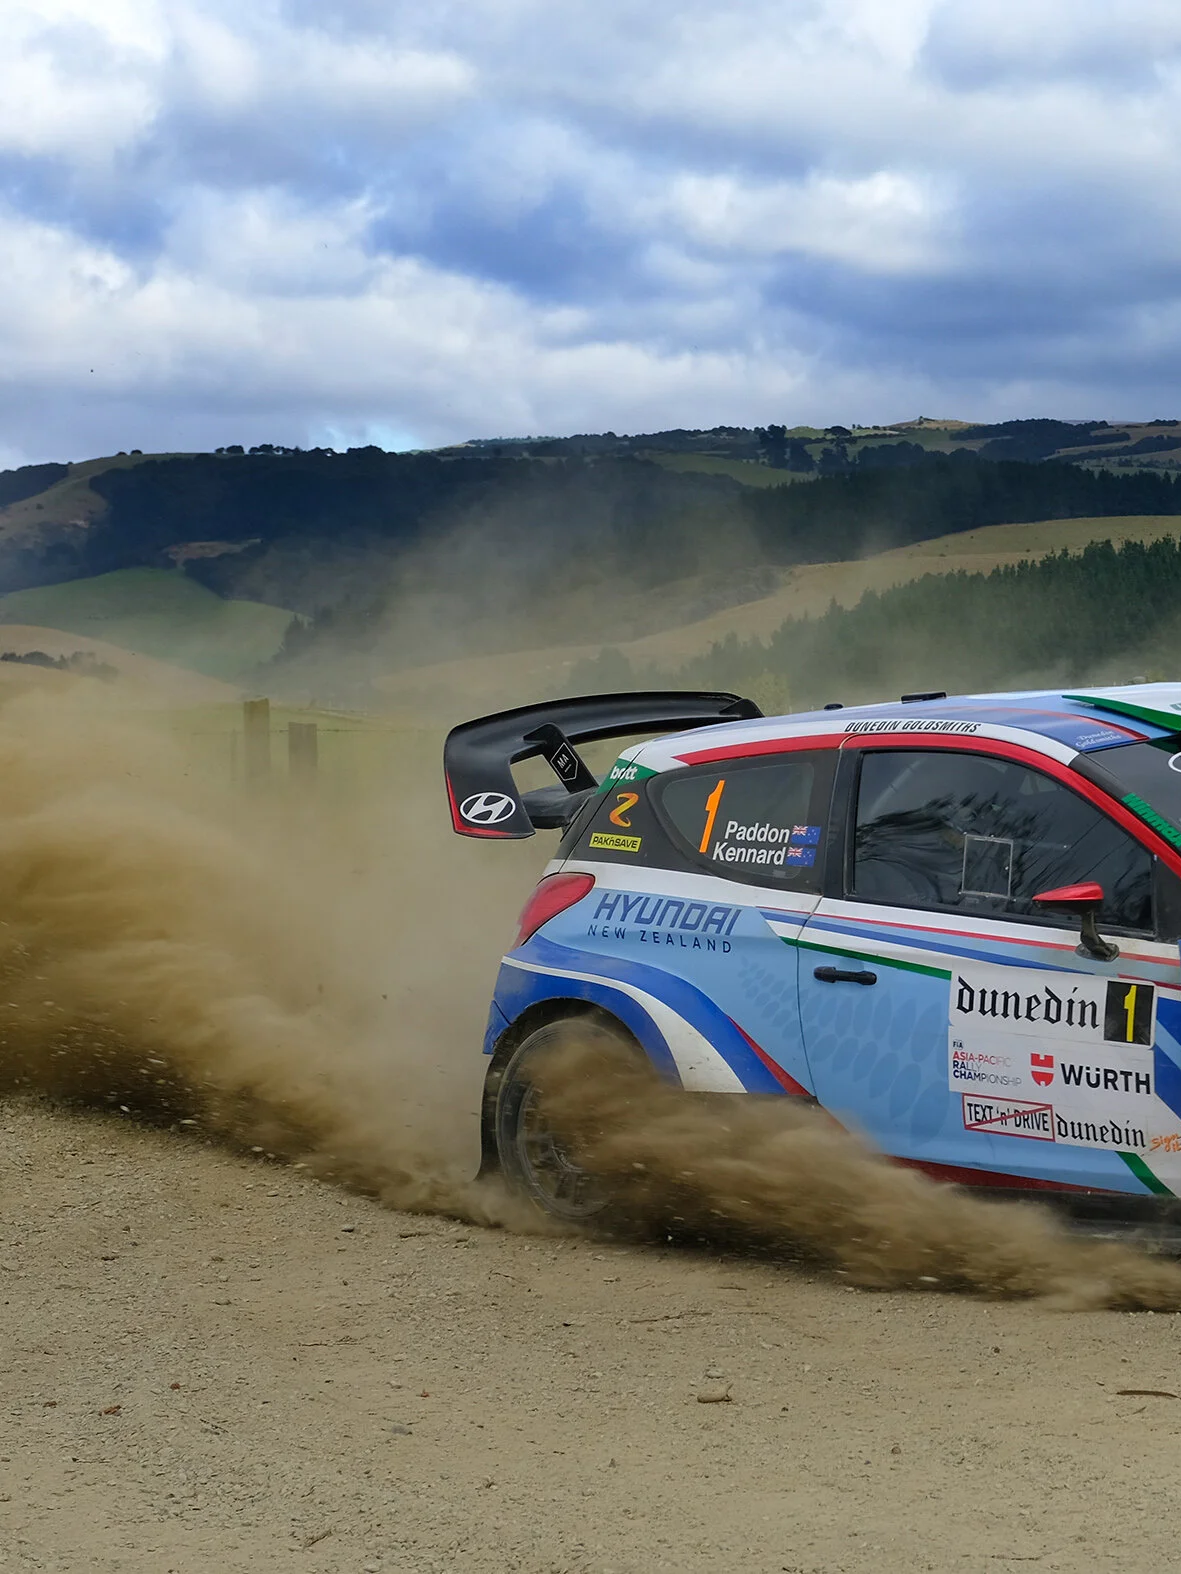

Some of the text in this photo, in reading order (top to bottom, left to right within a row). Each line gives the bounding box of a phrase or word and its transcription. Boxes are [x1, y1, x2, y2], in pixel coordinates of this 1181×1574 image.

[844, 720, 982, 733] DUNEDIN GOLDSMITHS
[699, 780, 726, 853] 1
[724, 820, 790, 844] Paddon
[712, 841, 787, 865] Kennard
[593, 893, 742, 936] HYUNDAI
[587, 925, 732, 953] NEW ZEALAND
[956, 975, 1137, 1043] dunedin 1
[953, 1041, 964, 1049] FIA
[952, 1051, 1012, 1068] ASIA-PACIFIC
[953, 1060, 982, 1072] RALLY
[953, 1070, 1022, 1086] CHAMPIONSHIP
[1060, 1062, 1151, 1095] WÜRTH
[966, 1102, 994, 1122] TEXT
[1014, 1110, 1050, 1132] DRIVE
[1055, 1113, 1146, 1148] dunedin
